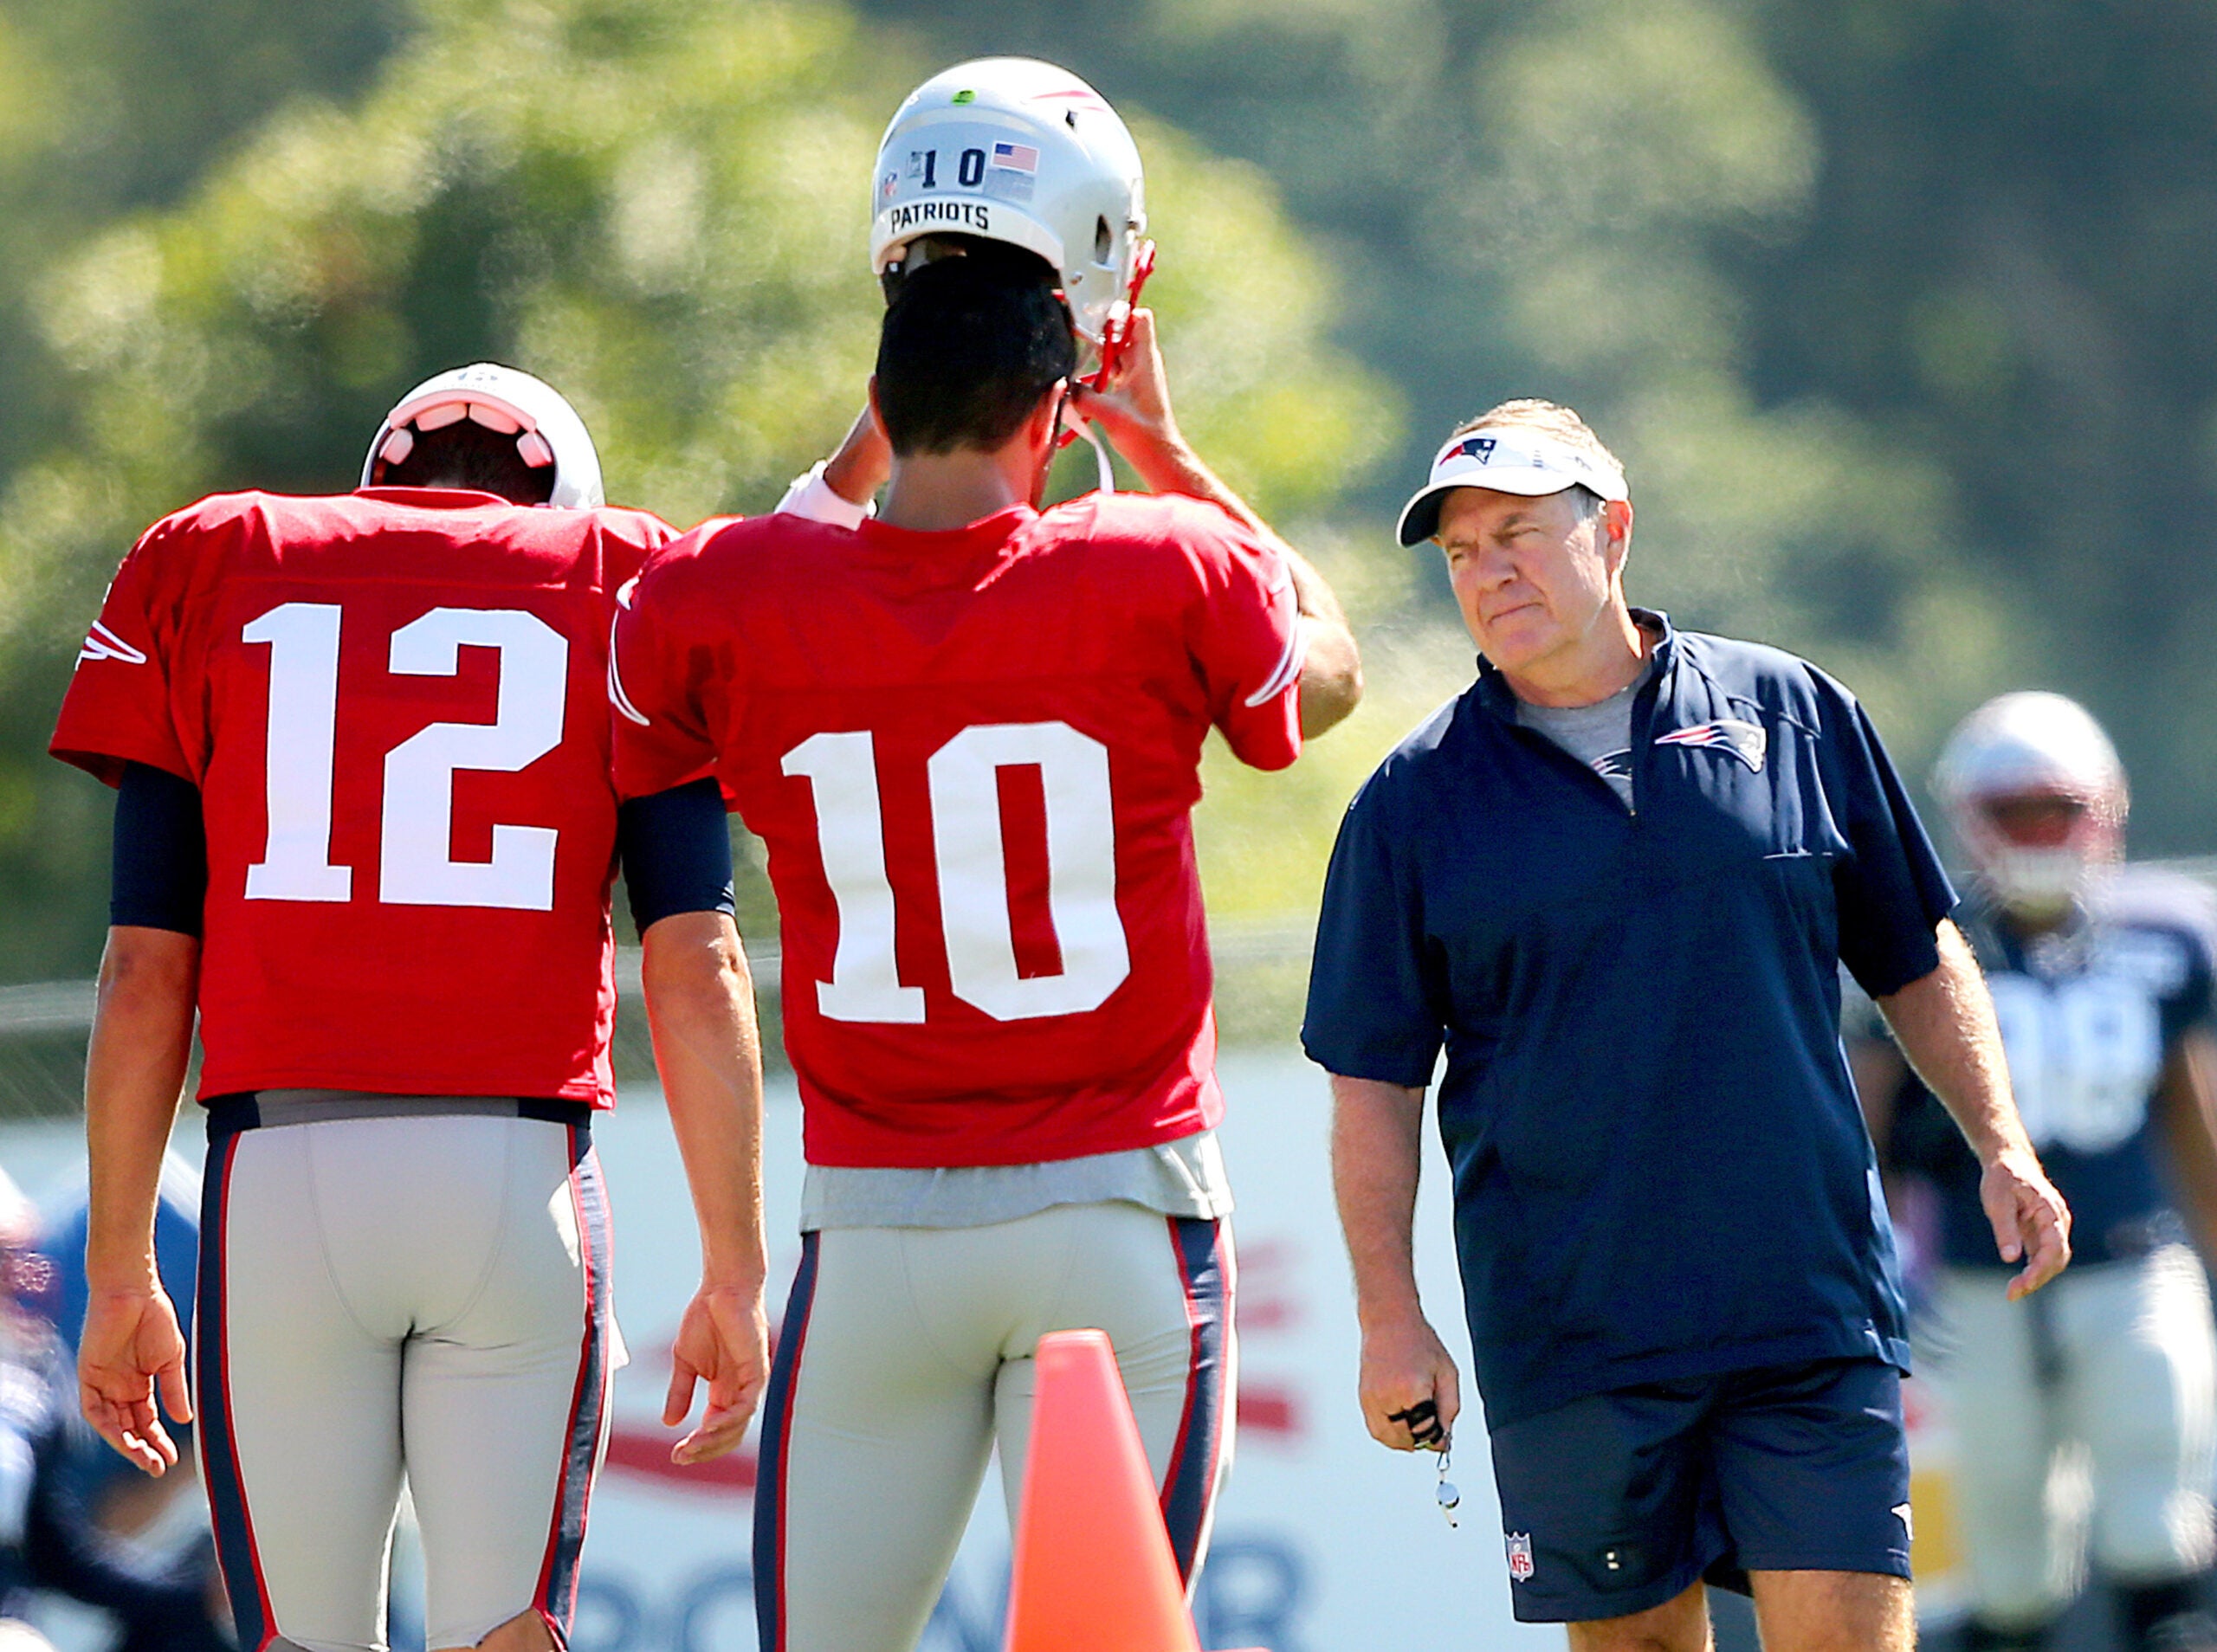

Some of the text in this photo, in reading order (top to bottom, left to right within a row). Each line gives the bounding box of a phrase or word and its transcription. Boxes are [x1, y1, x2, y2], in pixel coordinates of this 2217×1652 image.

[891, 202, 989, 234] PATRIOTS
[242, 602, 569, 911] 12
[780, 720, 1131, 1023] 10
